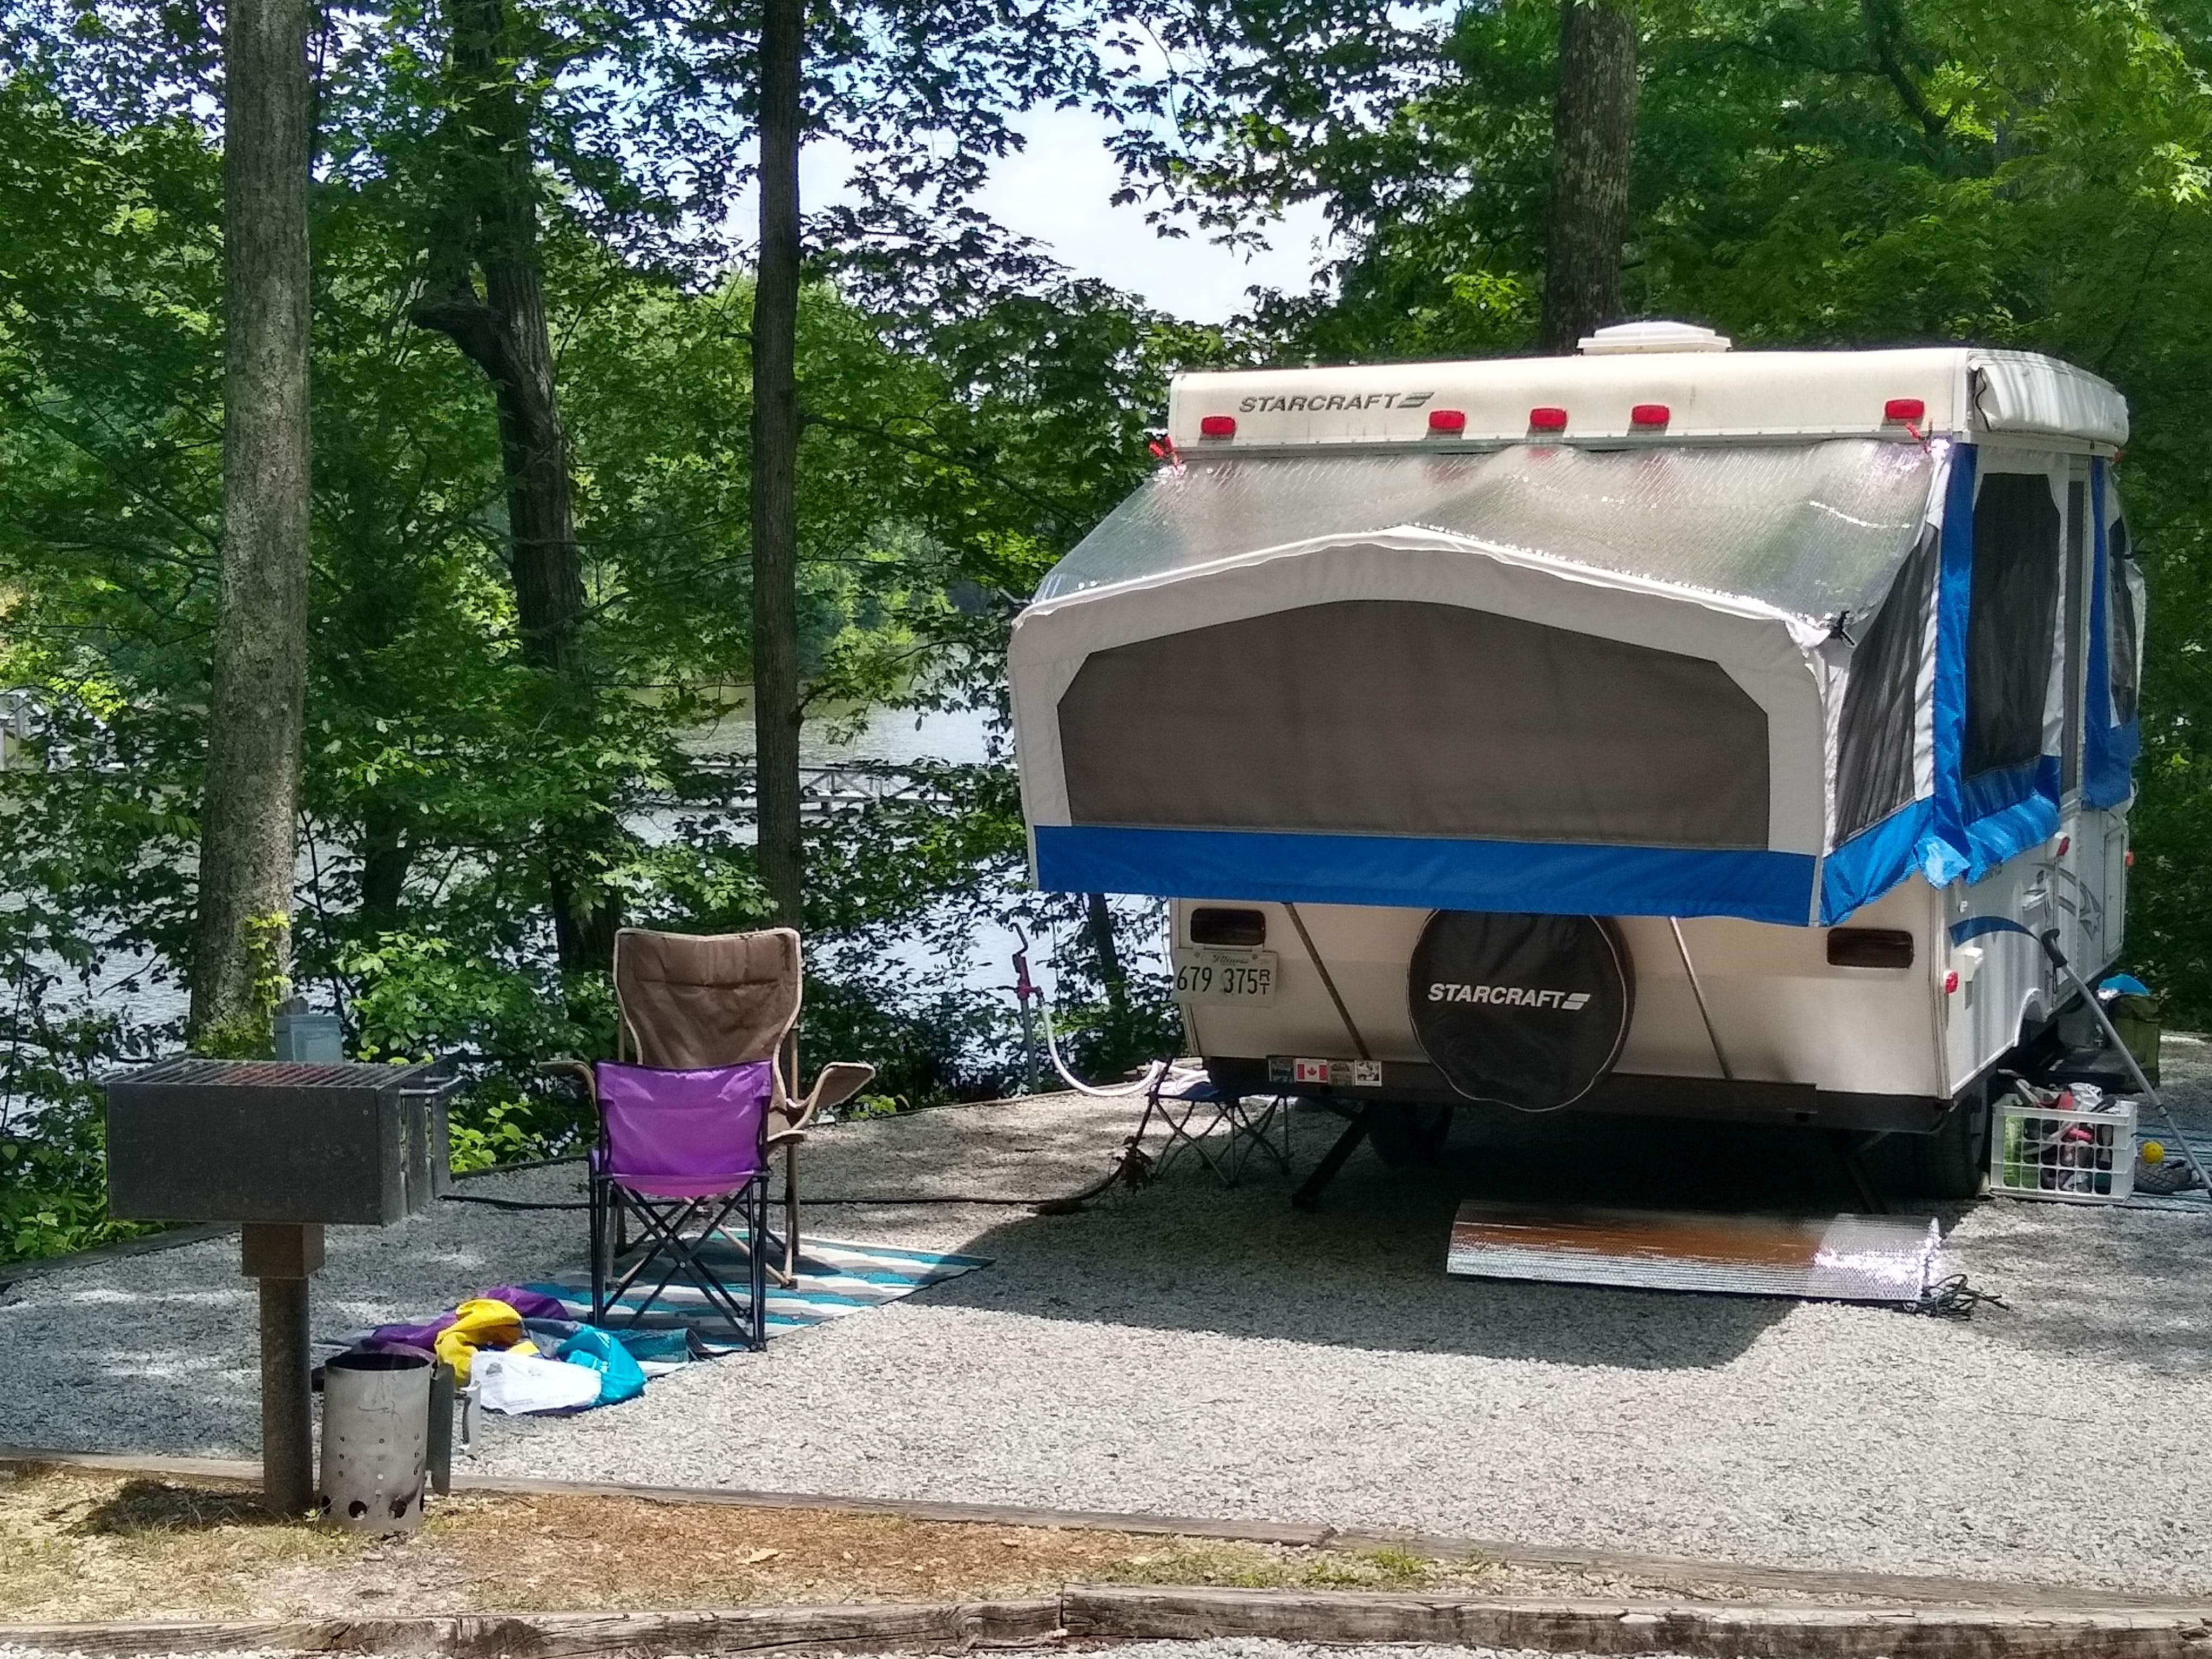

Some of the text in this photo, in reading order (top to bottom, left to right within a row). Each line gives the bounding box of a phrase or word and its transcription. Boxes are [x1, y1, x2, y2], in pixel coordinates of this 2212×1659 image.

[1239, 392, 1401, 413] STARCRAFT
[1177, 966, 1212, 992] 679
[1428, 983, 1566, 1009] STARCRAFT
